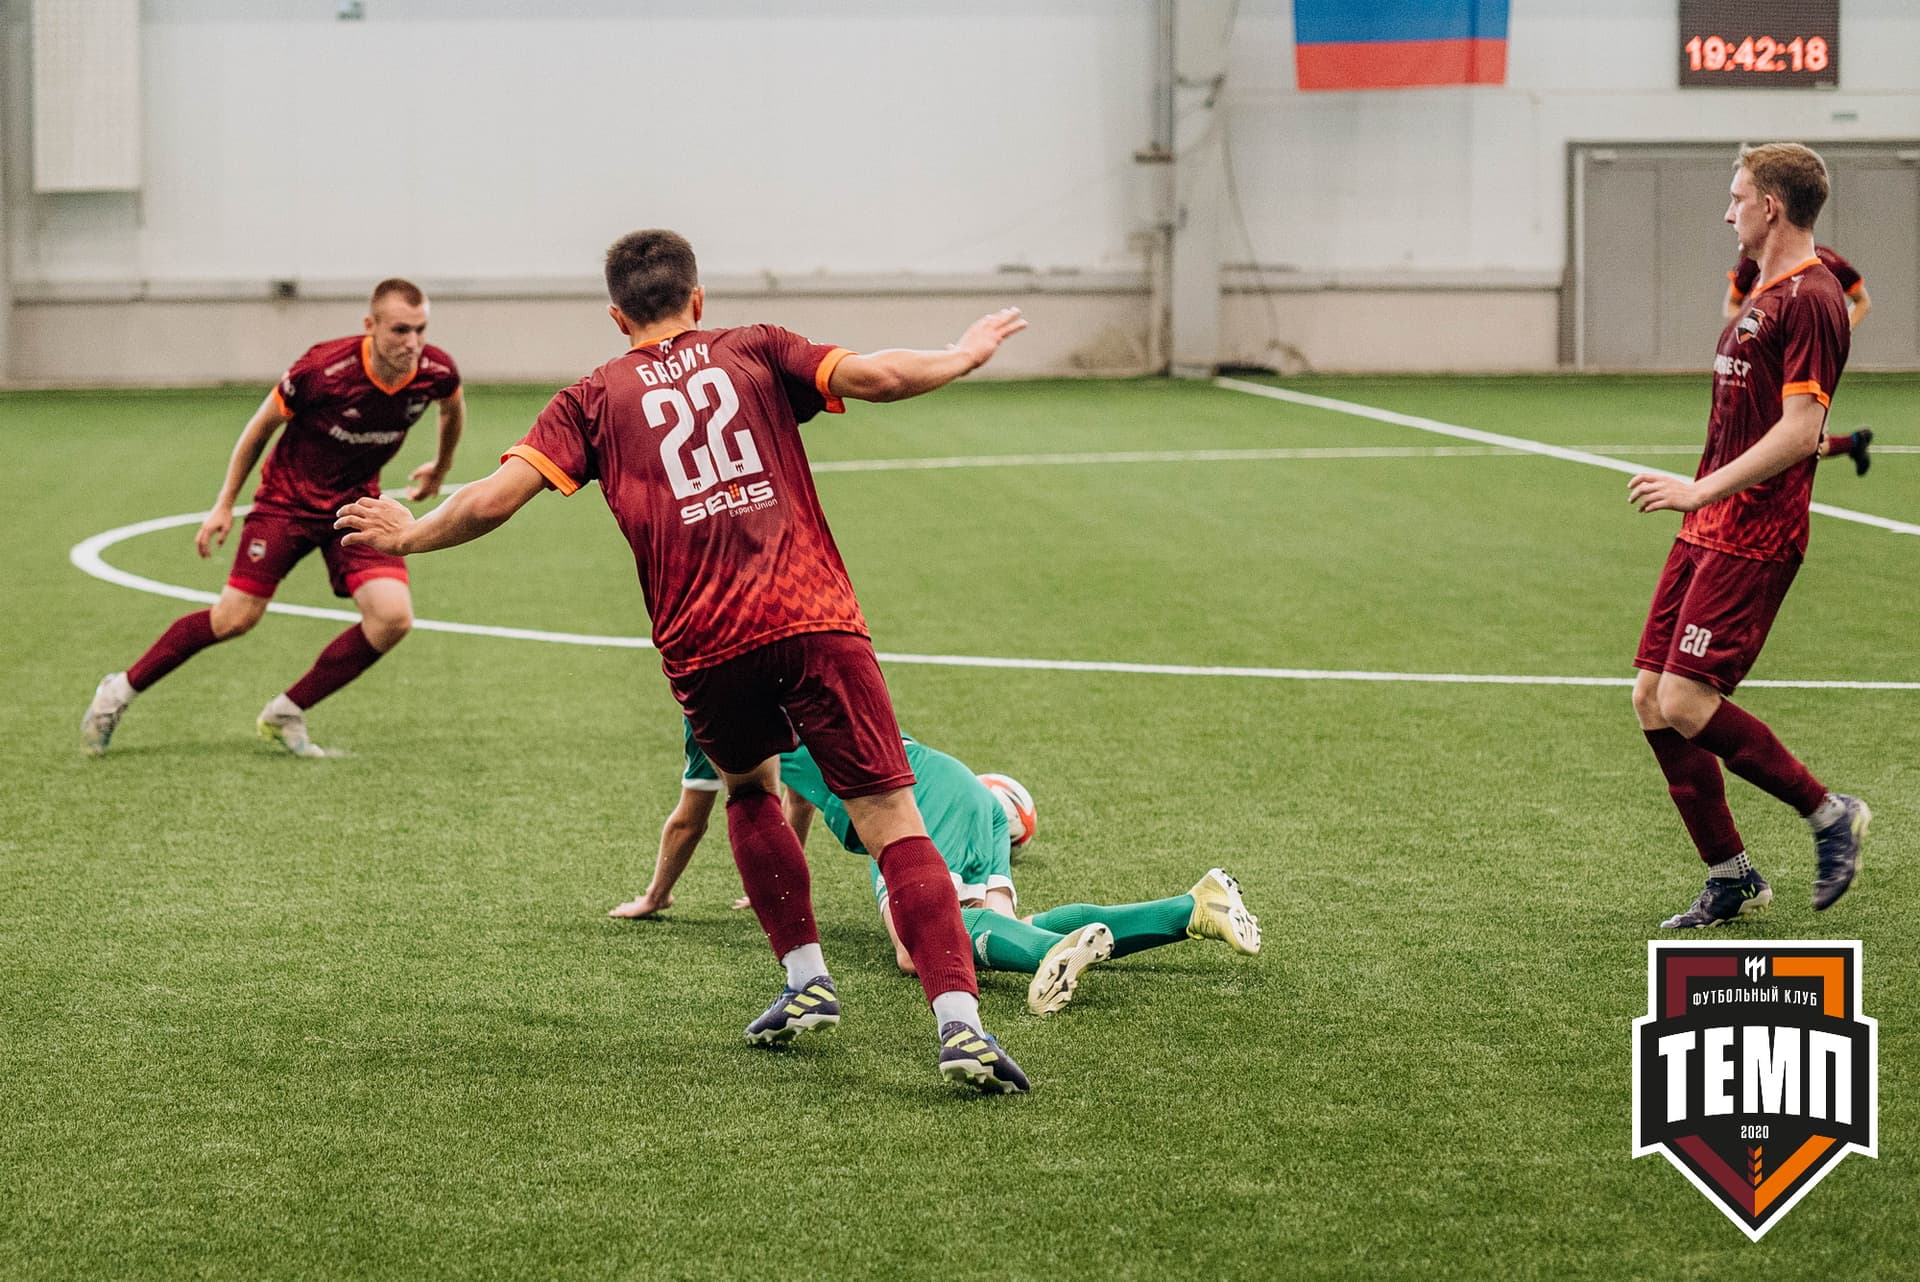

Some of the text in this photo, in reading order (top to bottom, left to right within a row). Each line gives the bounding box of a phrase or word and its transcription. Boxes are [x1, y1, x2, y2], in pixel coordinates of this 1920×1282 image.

[1685, 35, 1829, 72] 19:42:18
[635, 343, 711, 387] БАБИЧ
[641, 367, 764, 501] 22
[680, 480, 774, 525] SEUS
[729, 498, 778, 518] Export Union
[1679, 623, 1713, 658] 20
